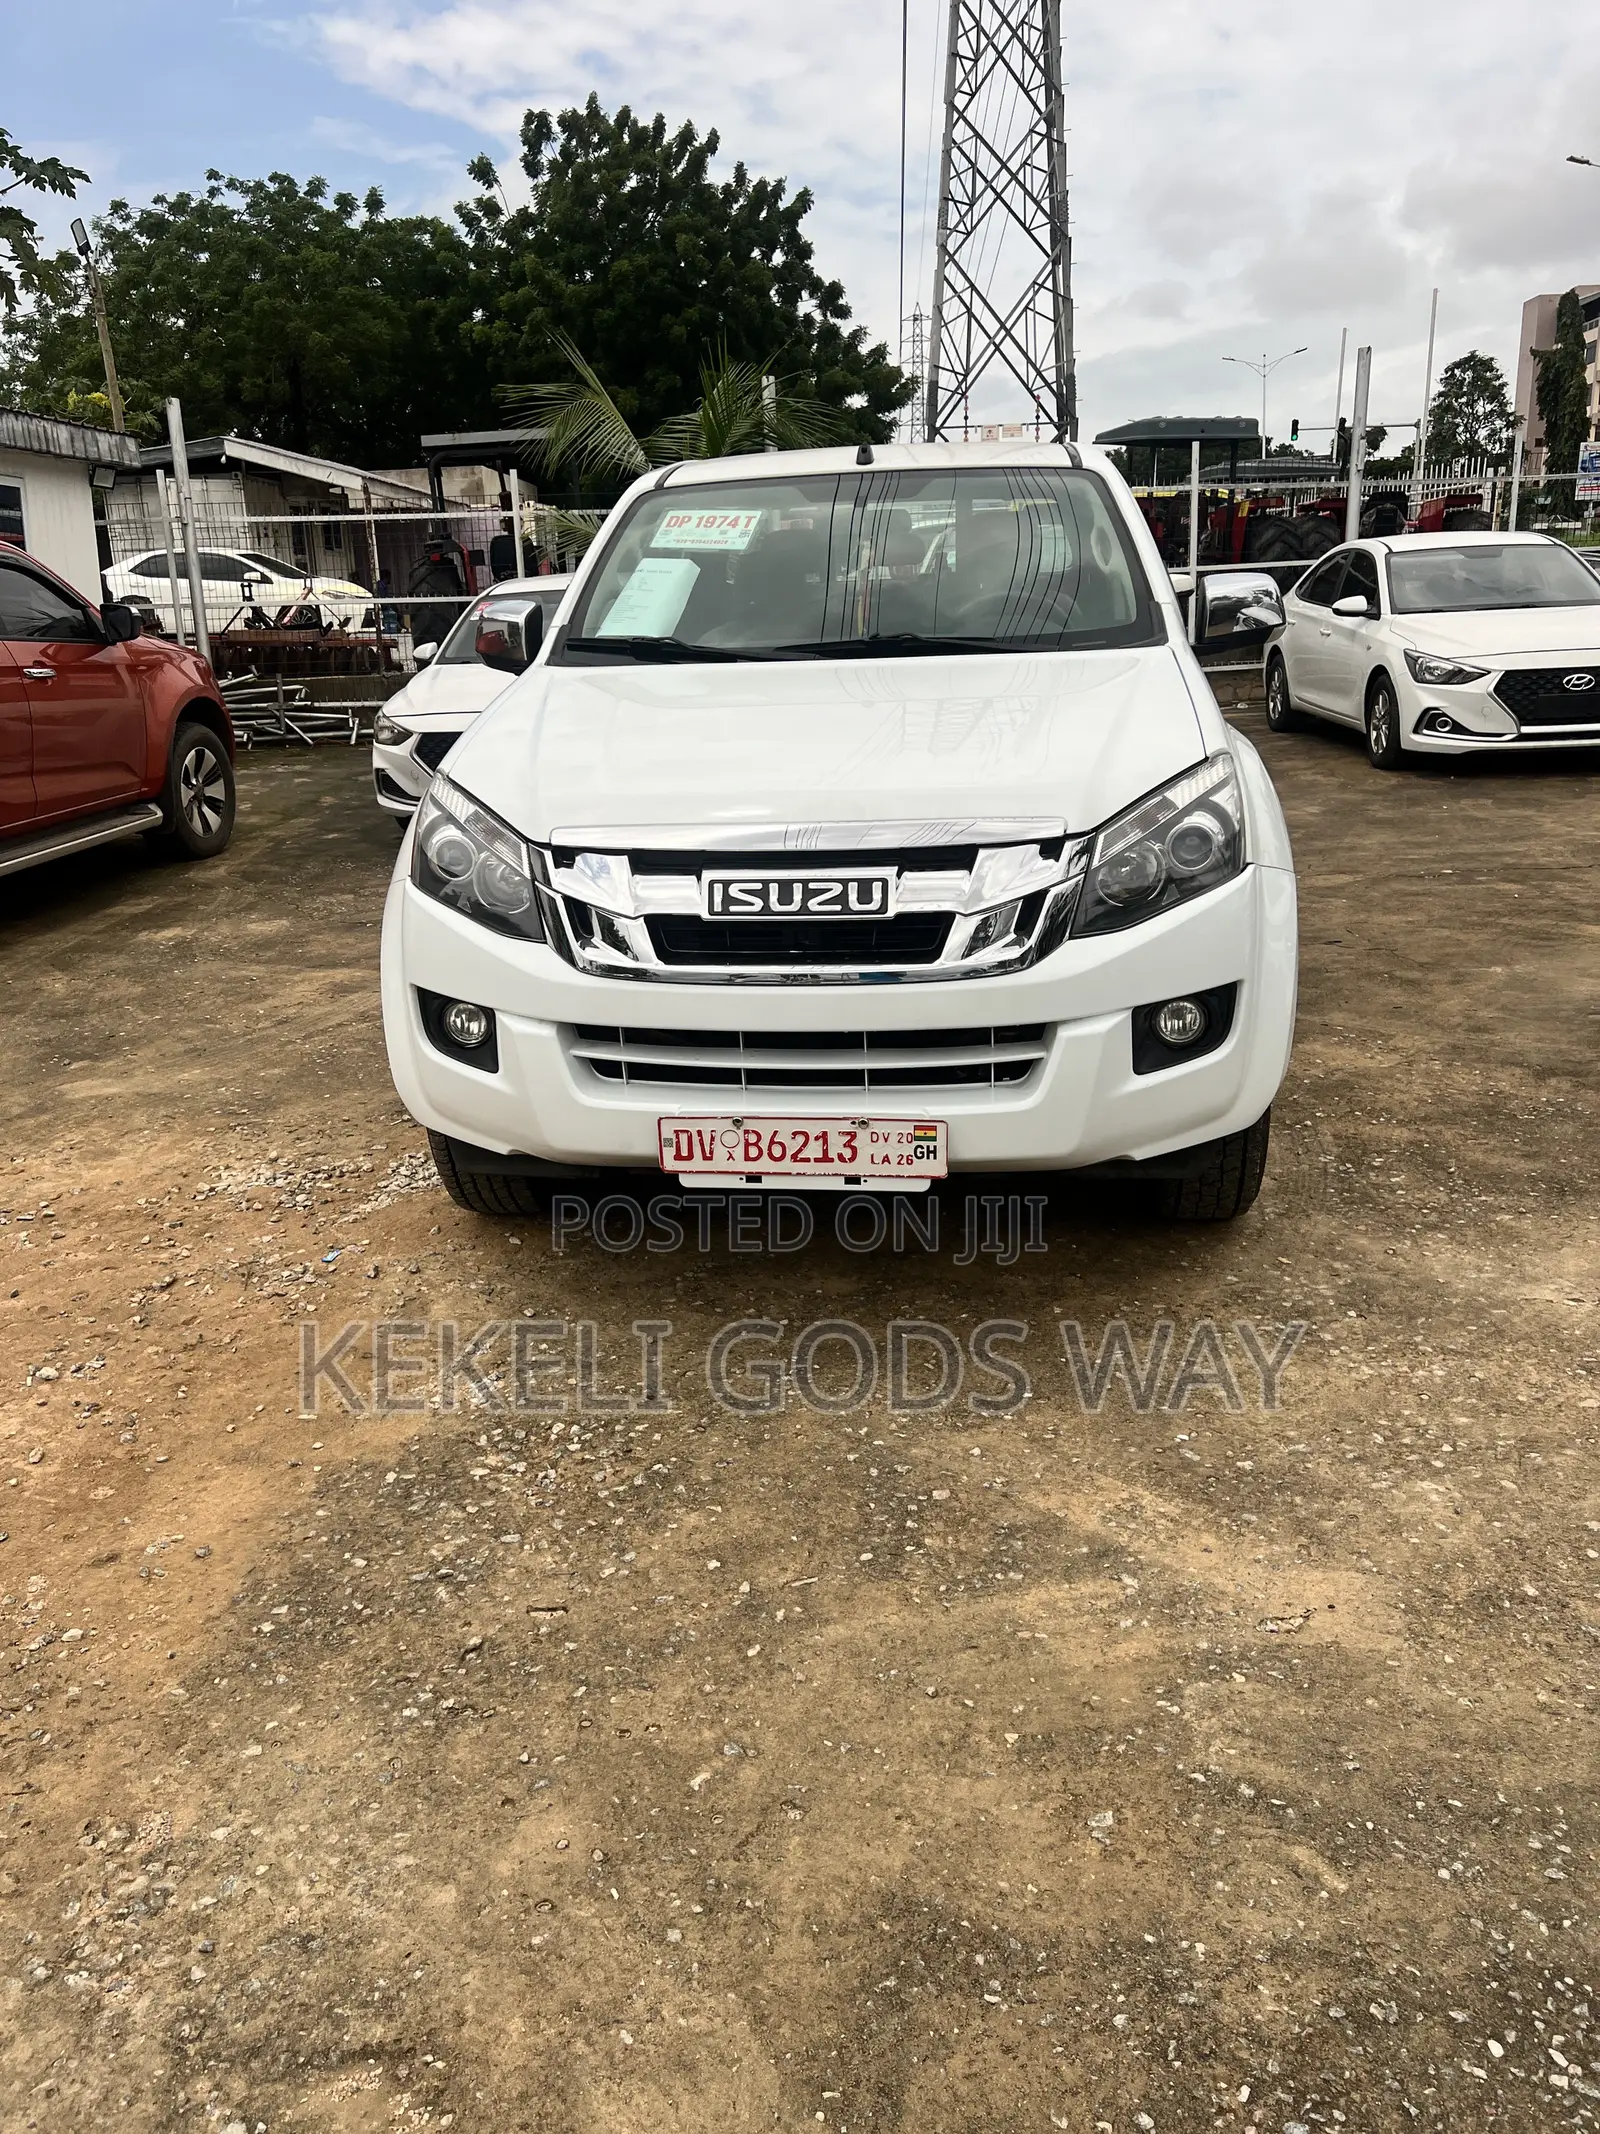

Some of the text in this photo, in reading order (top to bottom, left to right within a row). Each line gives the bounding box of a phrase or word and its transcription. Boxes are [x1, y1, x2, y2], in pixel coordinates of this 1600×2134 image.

[665, 515, 757, 529] DP 1974 T
[713, 881, 883, 912] ISUZU
[870, 1131, 914, 1144] DV 20
[673, 1129, 717, 1161] DV
[743, 1129, 858, 1163] B6213
[913, 1144, 938, 1160] GH
[870, 1153, 914, 1166] LA 26
